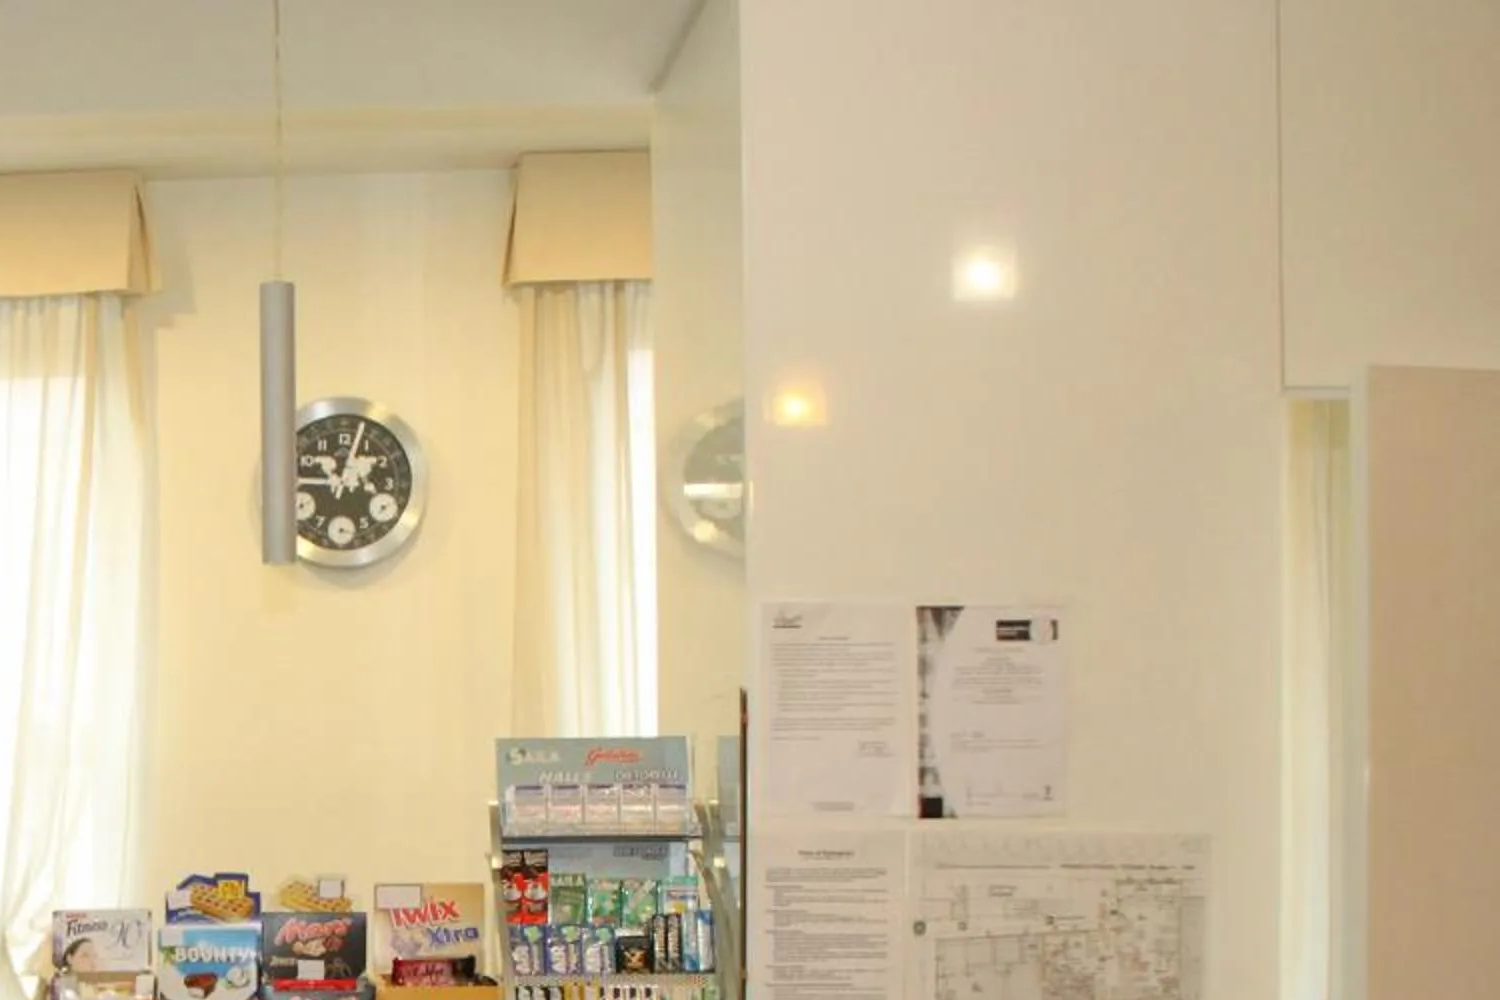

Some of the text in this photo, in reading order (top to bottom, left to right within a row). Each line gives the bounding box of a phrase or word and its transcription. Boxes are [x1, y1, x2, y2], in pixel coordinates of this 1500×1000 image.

[317, 439, 327, 451] 11
[339, 433, 350, 445] 12
[301, 456, 315, 467] 10
[378, 455, 387, 468] 2
[384, 478, 393, 491] 3
[316, 517, 325, 531] 7
[360, 517, 369, 529] 5
[275, 918, 352, 946] Mars
[427, 926, 479, 947] Xtra
[173, 943, 251, 963] BOUNTY
